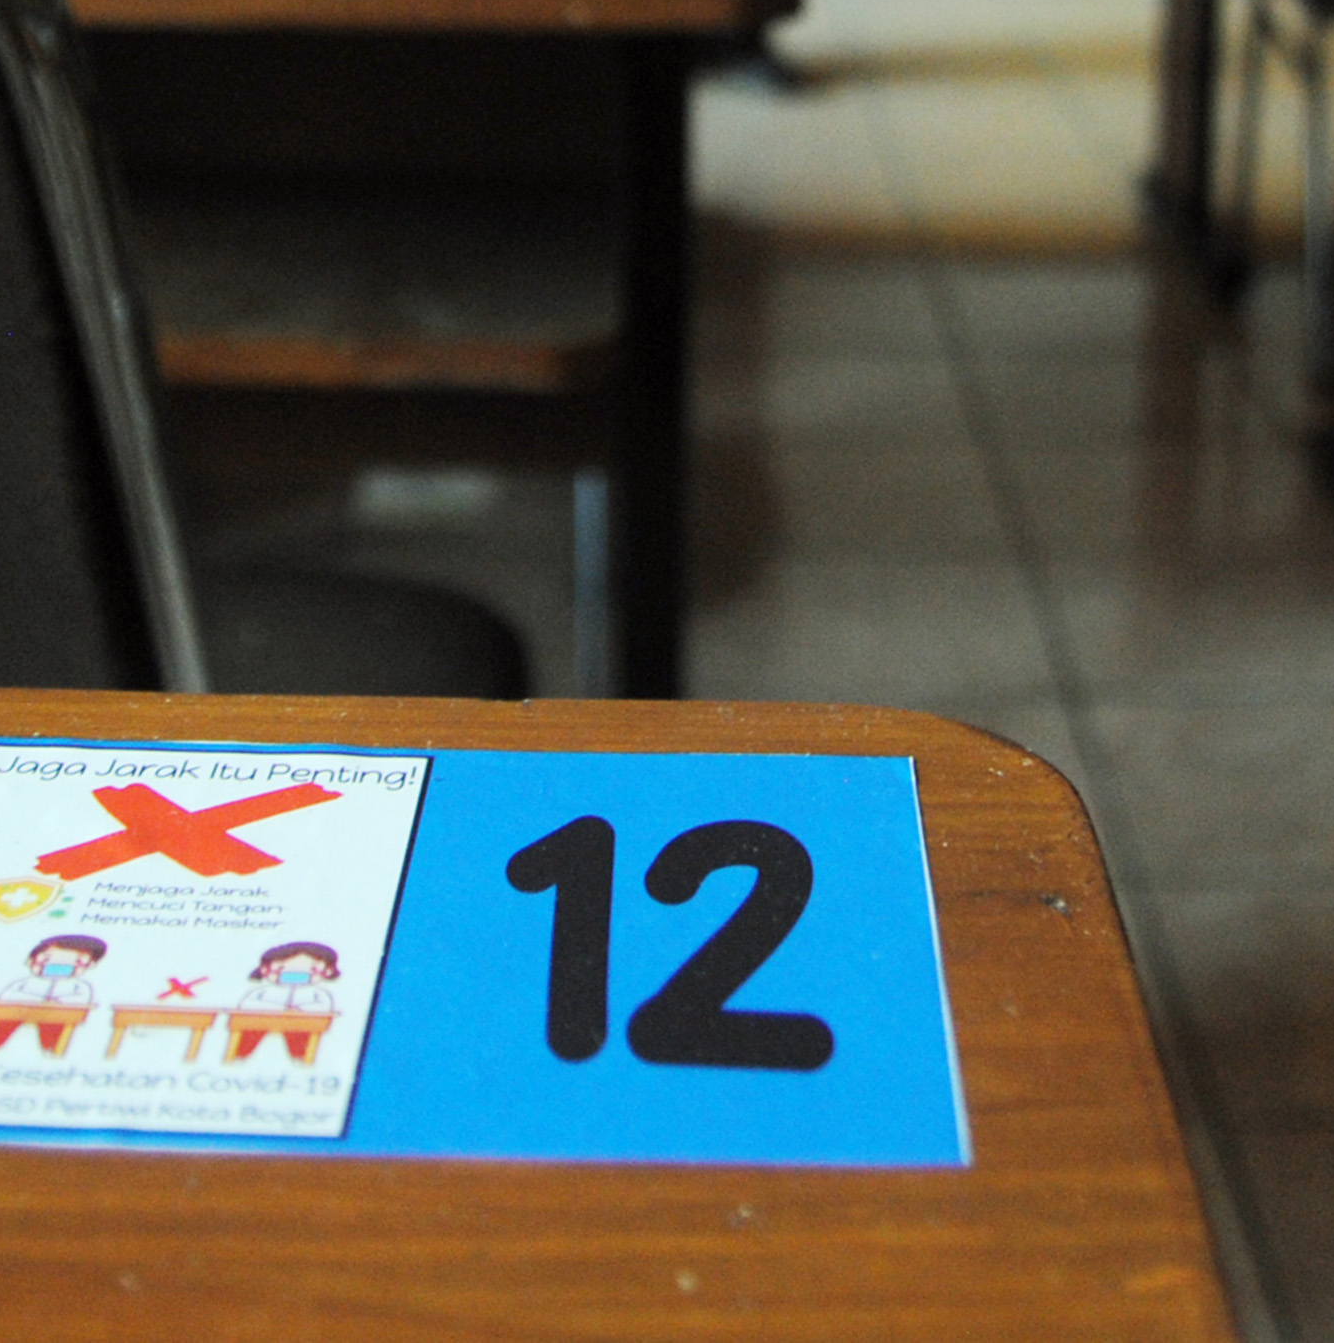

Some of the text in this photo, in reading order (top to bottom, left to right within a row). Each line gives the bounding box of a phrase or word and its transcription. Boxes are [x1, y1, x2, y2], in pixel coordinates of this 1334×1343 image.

[94, 758, 201, 780] Jarak
[209, 761, 258, 781] Itu
[266, 762, 418, 791] Penting!
[93, 882, 270, 898] Menjaga Jarak
[86, 896, 284, 916] Mencuci Tangan
[79, 912, 285, 930] Memakai Masker
[505, 814, 835, 1073] 12
[186, 1070, 341, 1096] Covid-19
[157, 1102, 231, 1123] Kota
[238, 1105, 336, 1132] Bogor
